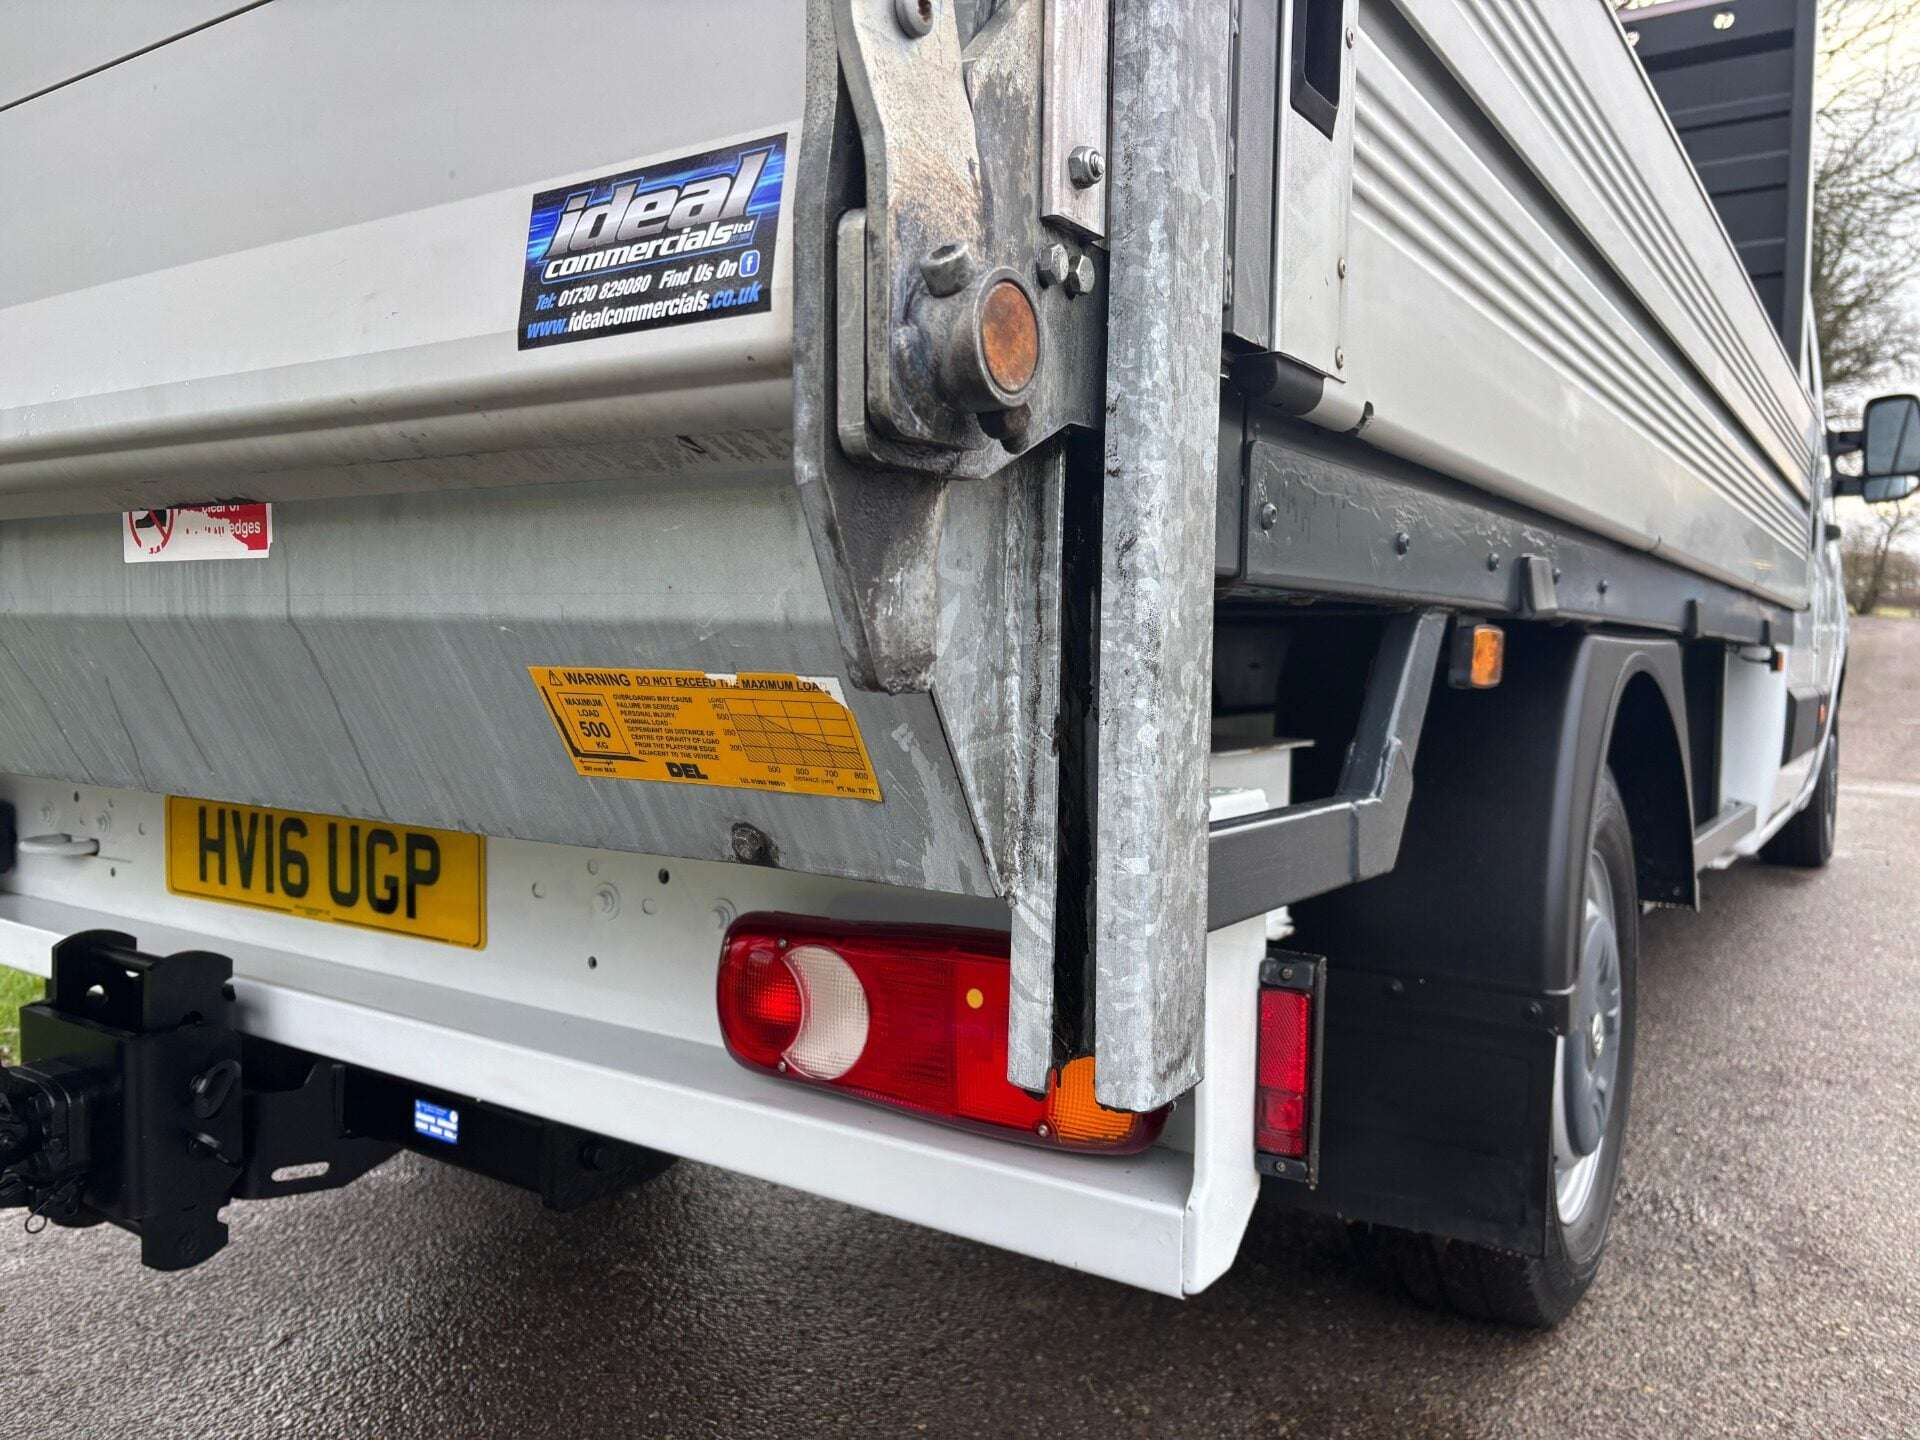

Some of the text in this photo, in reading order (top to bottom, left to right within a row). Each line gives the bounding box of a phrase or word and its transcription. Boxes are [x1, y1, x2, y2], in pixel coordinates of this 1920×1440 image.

[546, 152, 769, 256] ideal
[544, 220, 755, 279] commercials ltd
[535, 293, 557, 311] Tel:
[558, 284, 598, 307] 01730
[599, 274, 652, 300] 829080
[659, 266, 693, 289] Find
[694, 263, 714, 282] Us
[716, 259, 738, 279] On
[527, 281, 762, 339] www.idealcommercials.co.uk
[229, 519, 261, 538] edges
[563, 672, 631, 687] WARNING
[636, 675, 650, 686] DO
[653, 676, 672, 687] NOT
[676, 677, 716, 688] EXCEED
[742, 679, 794, 691] MAXIMUM
[796, 681, 822, 692] LOA
[564, 697, 602, 707] MAXIMUM
[577, 709, 600, 718] LOAD
[578, 721, 611, 738] 500
[665, 762, 709, 780] DEL
[199, 806, 441, 920] HV16 UGP
